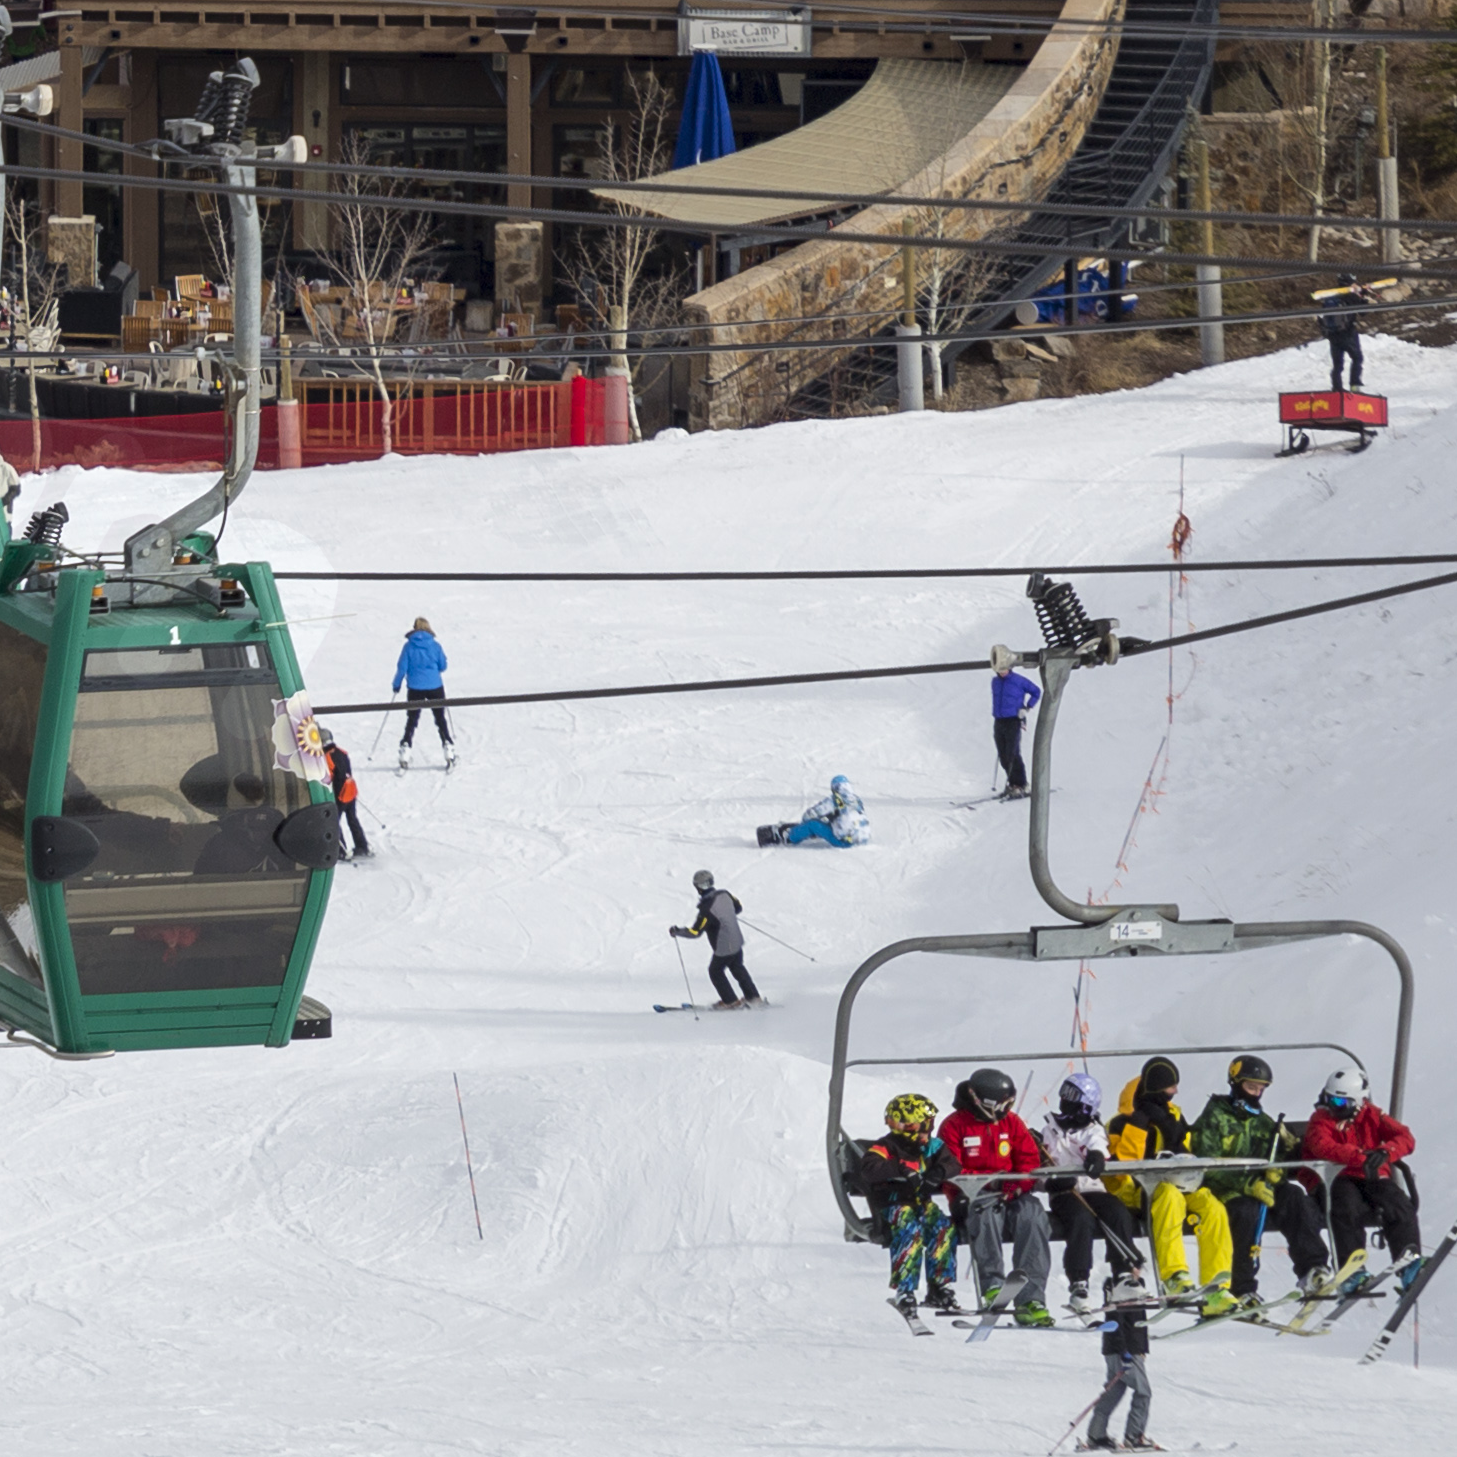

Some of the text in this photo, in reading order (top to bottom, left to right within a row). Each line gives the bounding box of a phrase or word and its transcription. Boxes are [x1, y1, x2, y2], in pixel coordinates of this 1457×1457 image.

[711, 23, 780, 39] Base Camp
[169, 625, 181, 646] 1
[1117, 925, 1129, 938] 14
